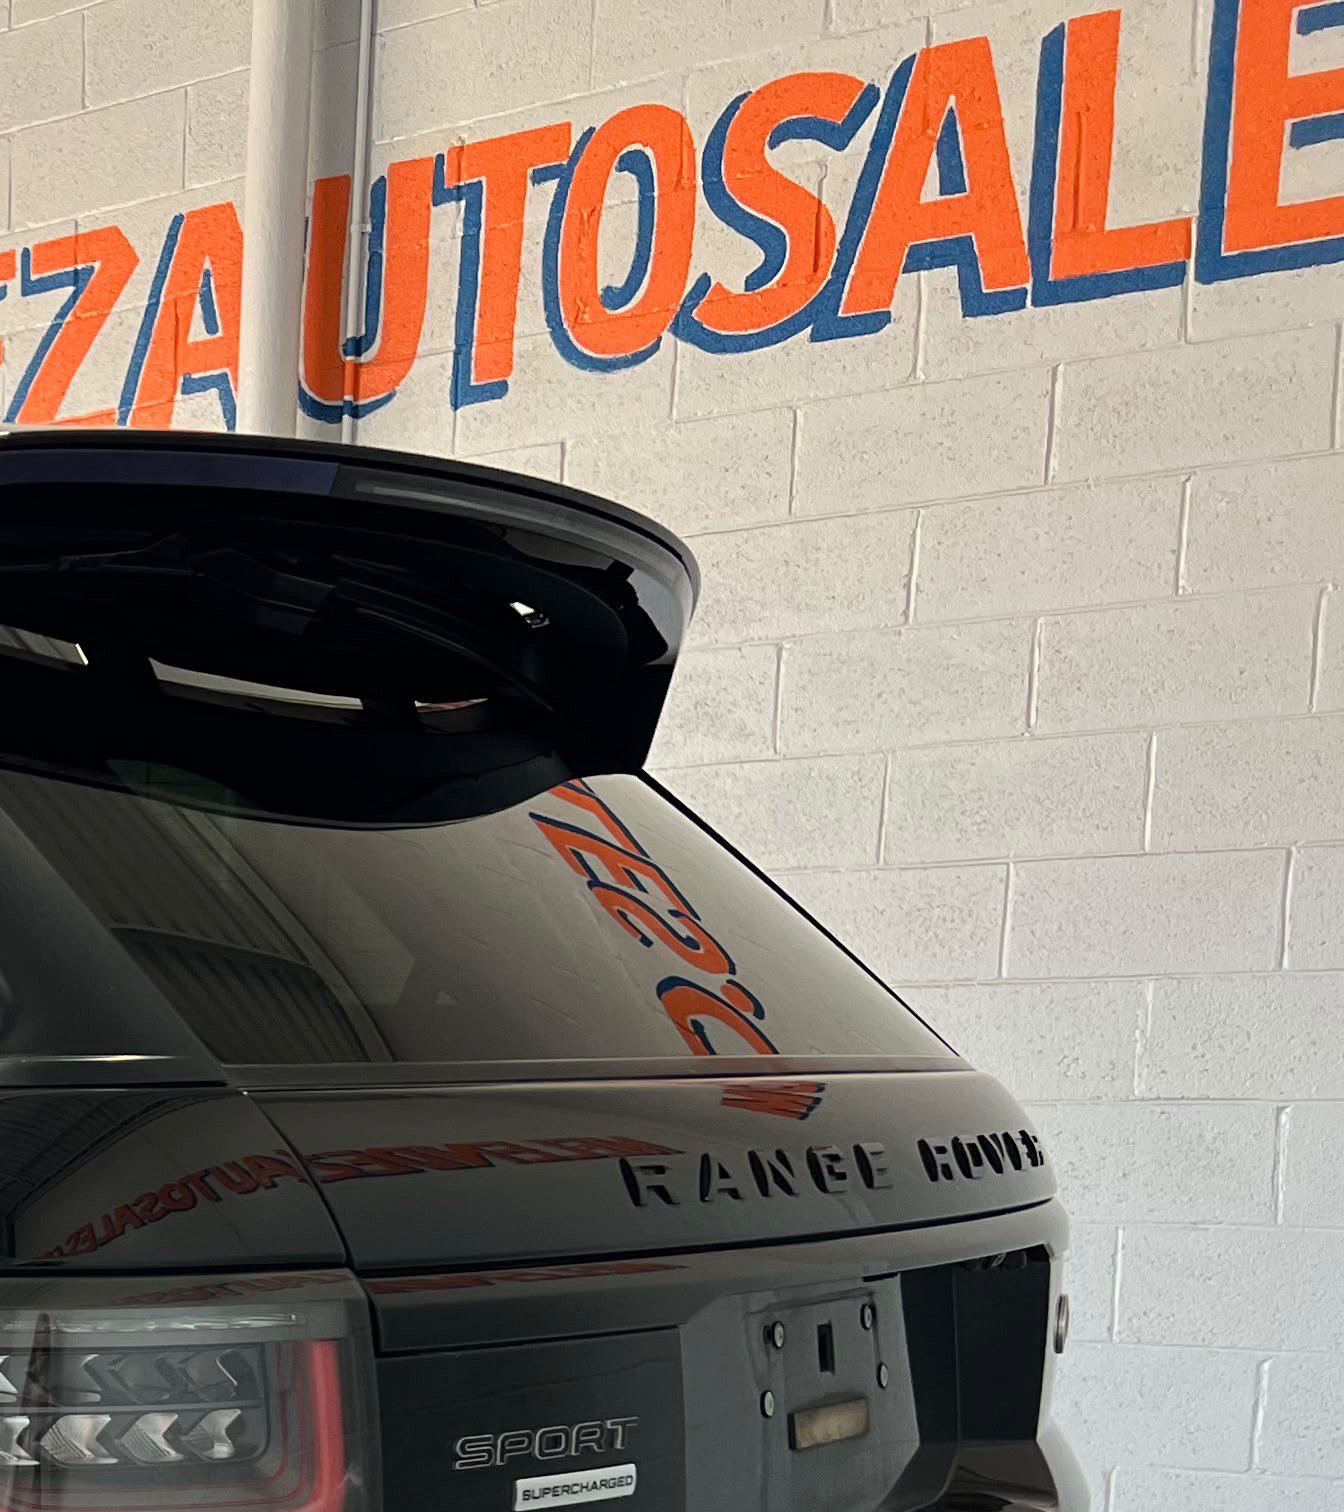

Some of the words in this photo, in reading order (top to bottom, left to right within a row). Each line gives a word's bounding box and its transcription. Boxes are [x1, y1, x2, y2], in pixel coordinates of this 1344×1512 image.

[618, 1142, 893, 1207] RANGE
[454, 1416, 639, 1469] SPORT
[522, 1475, 633, 1501] SUPERCHARGED
